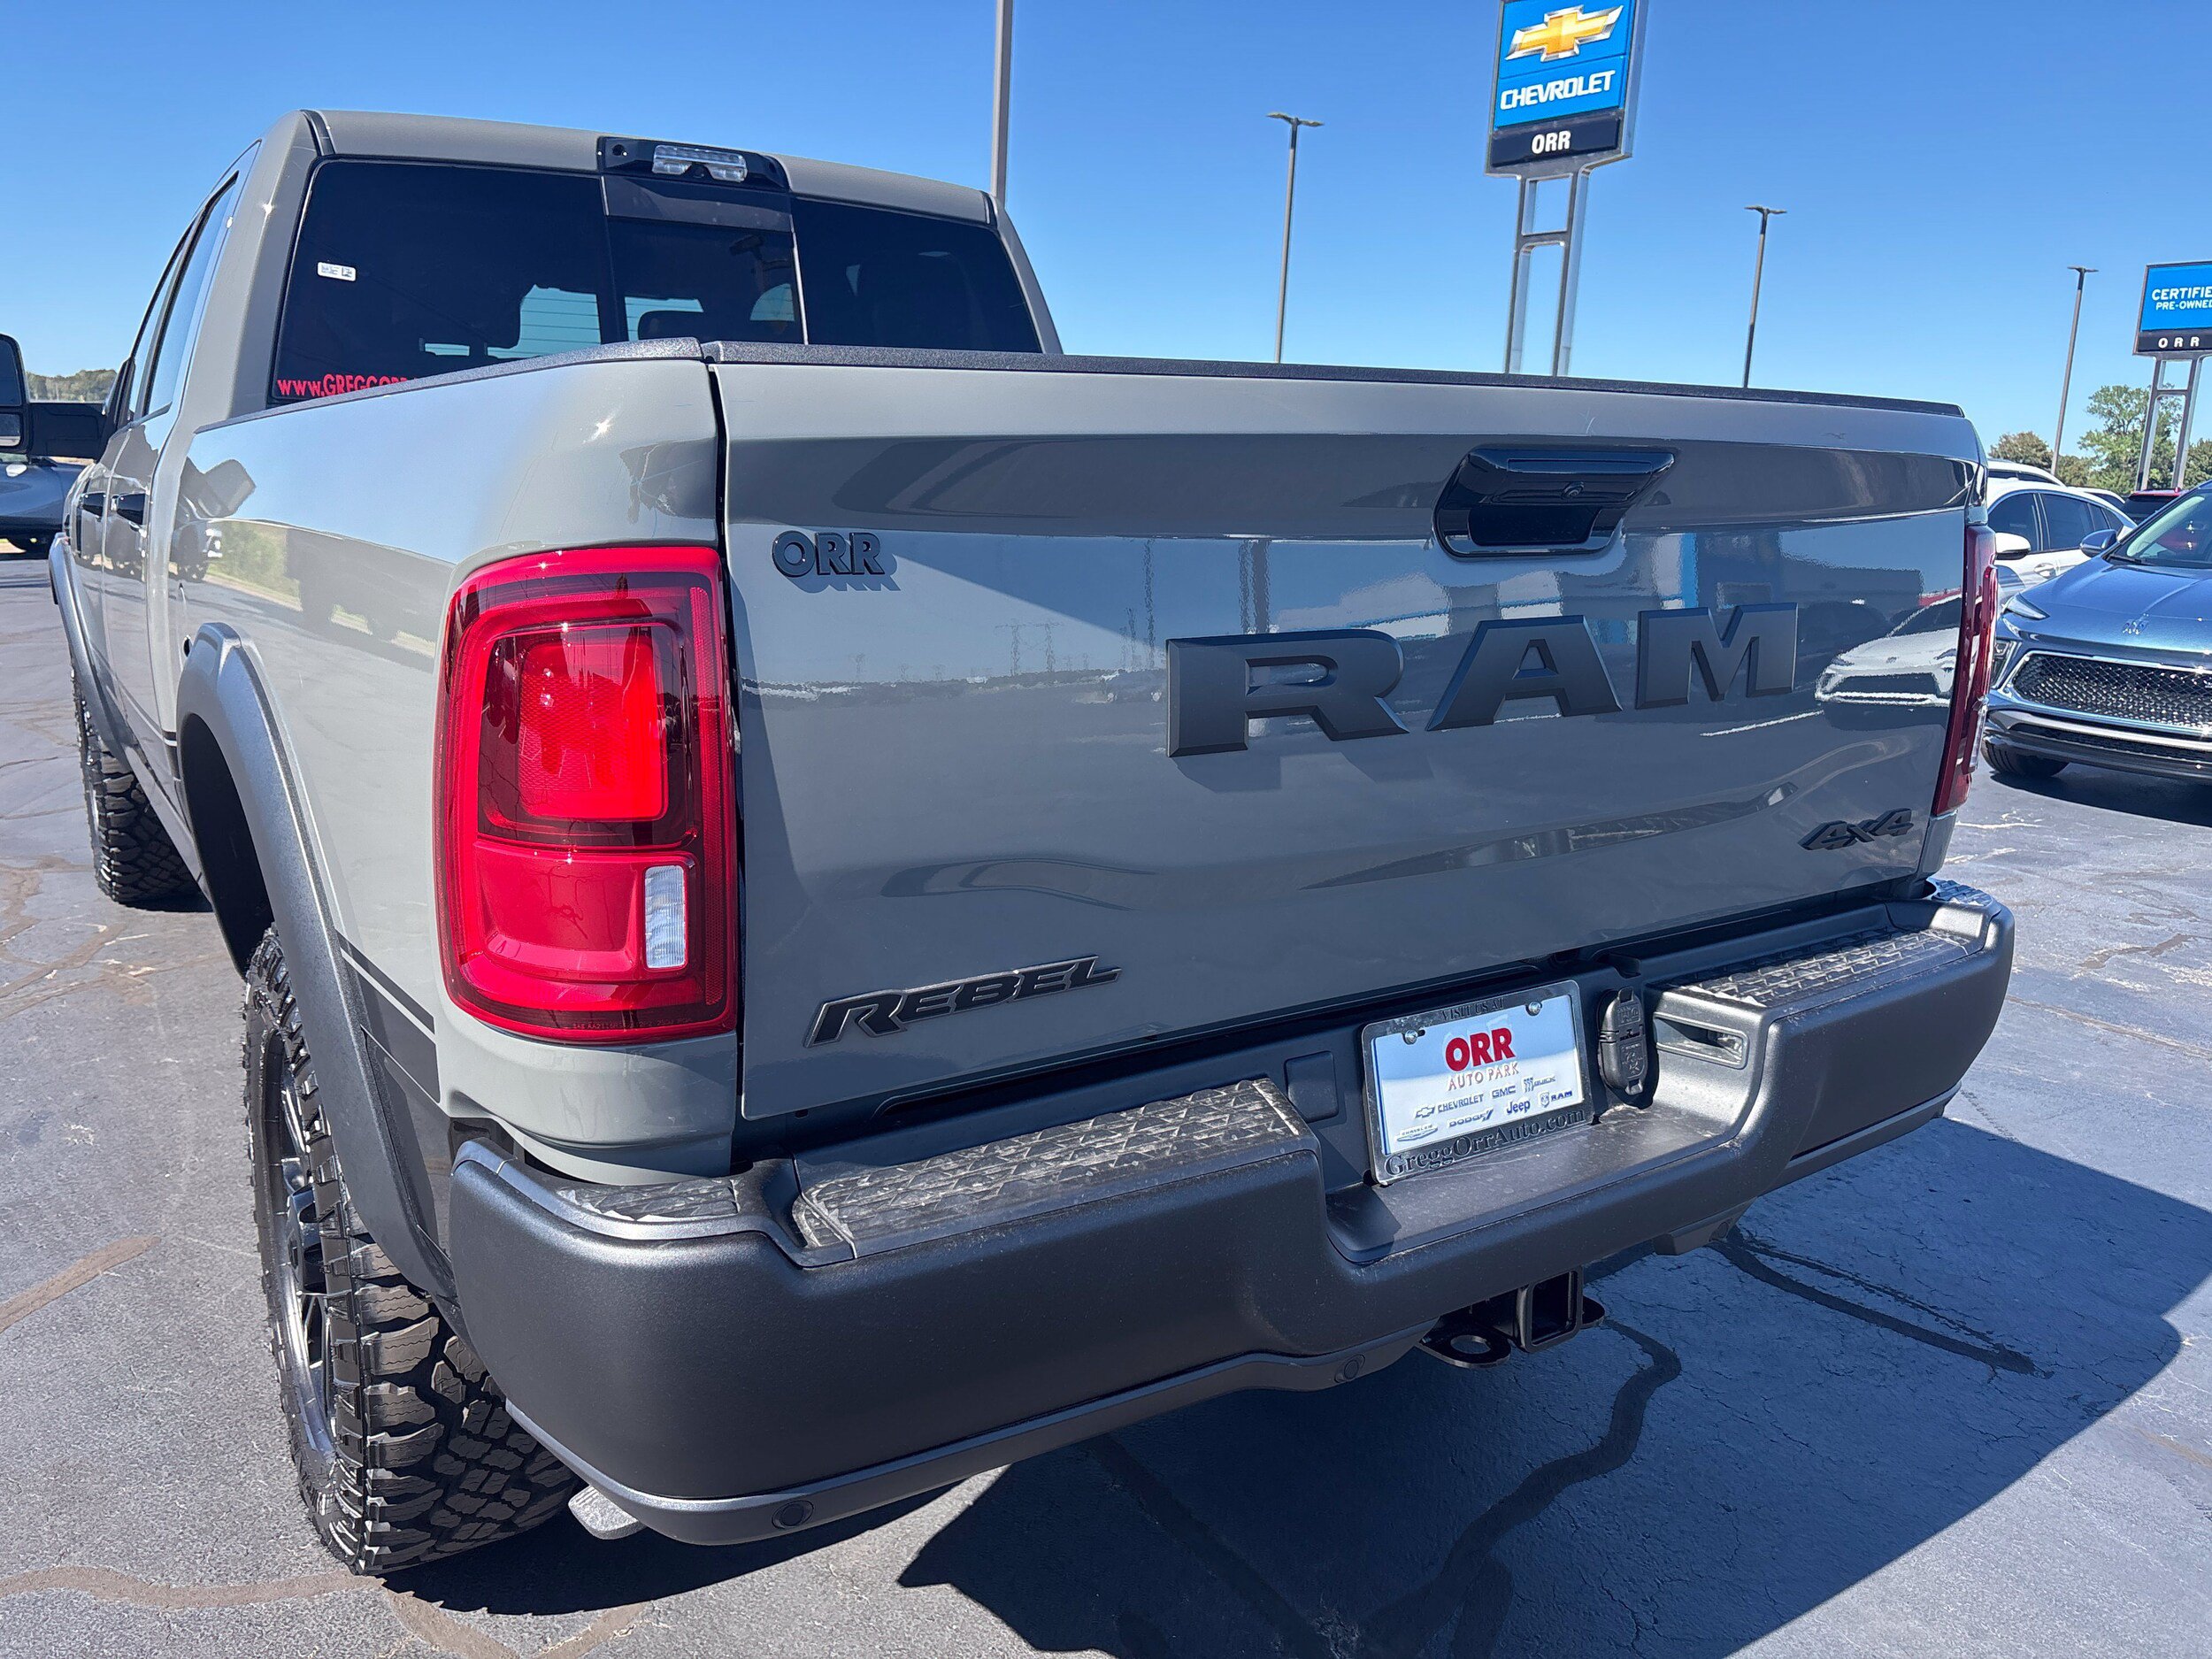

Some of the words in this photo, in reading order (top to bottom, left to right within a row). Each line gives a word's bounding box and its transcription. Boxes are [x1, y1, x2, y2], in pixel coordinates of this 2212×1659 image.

[1500, 70, 1616, 110] CHEVROLET
[1532, 131, 1571, 154] ORR
[772, 530, 886, 578] ORR
[1165, 602, 1798, 757] RAM
[803, 954, 1122, 1048] REBEL
[1440, 1006, 1471, 1020] VISIT
[1475, 1001, 1487, 1014] US
[1445, 1027, 1516, 1071] ORR
[1448, 1071, 1484, 1092] AUTO
[1487, 1063, 1520, 1081] PARK
[1438, 1094, 1484, 1113] CHEVROLET
[1492, 1085, 1517, 1099] GMC
[1506, 1099, 1531, 1115] Jeep
[1550, 1090, 1573, 1102] RAM
[1385, 1110, 1585, 1178] GreggOrrAuto.com
